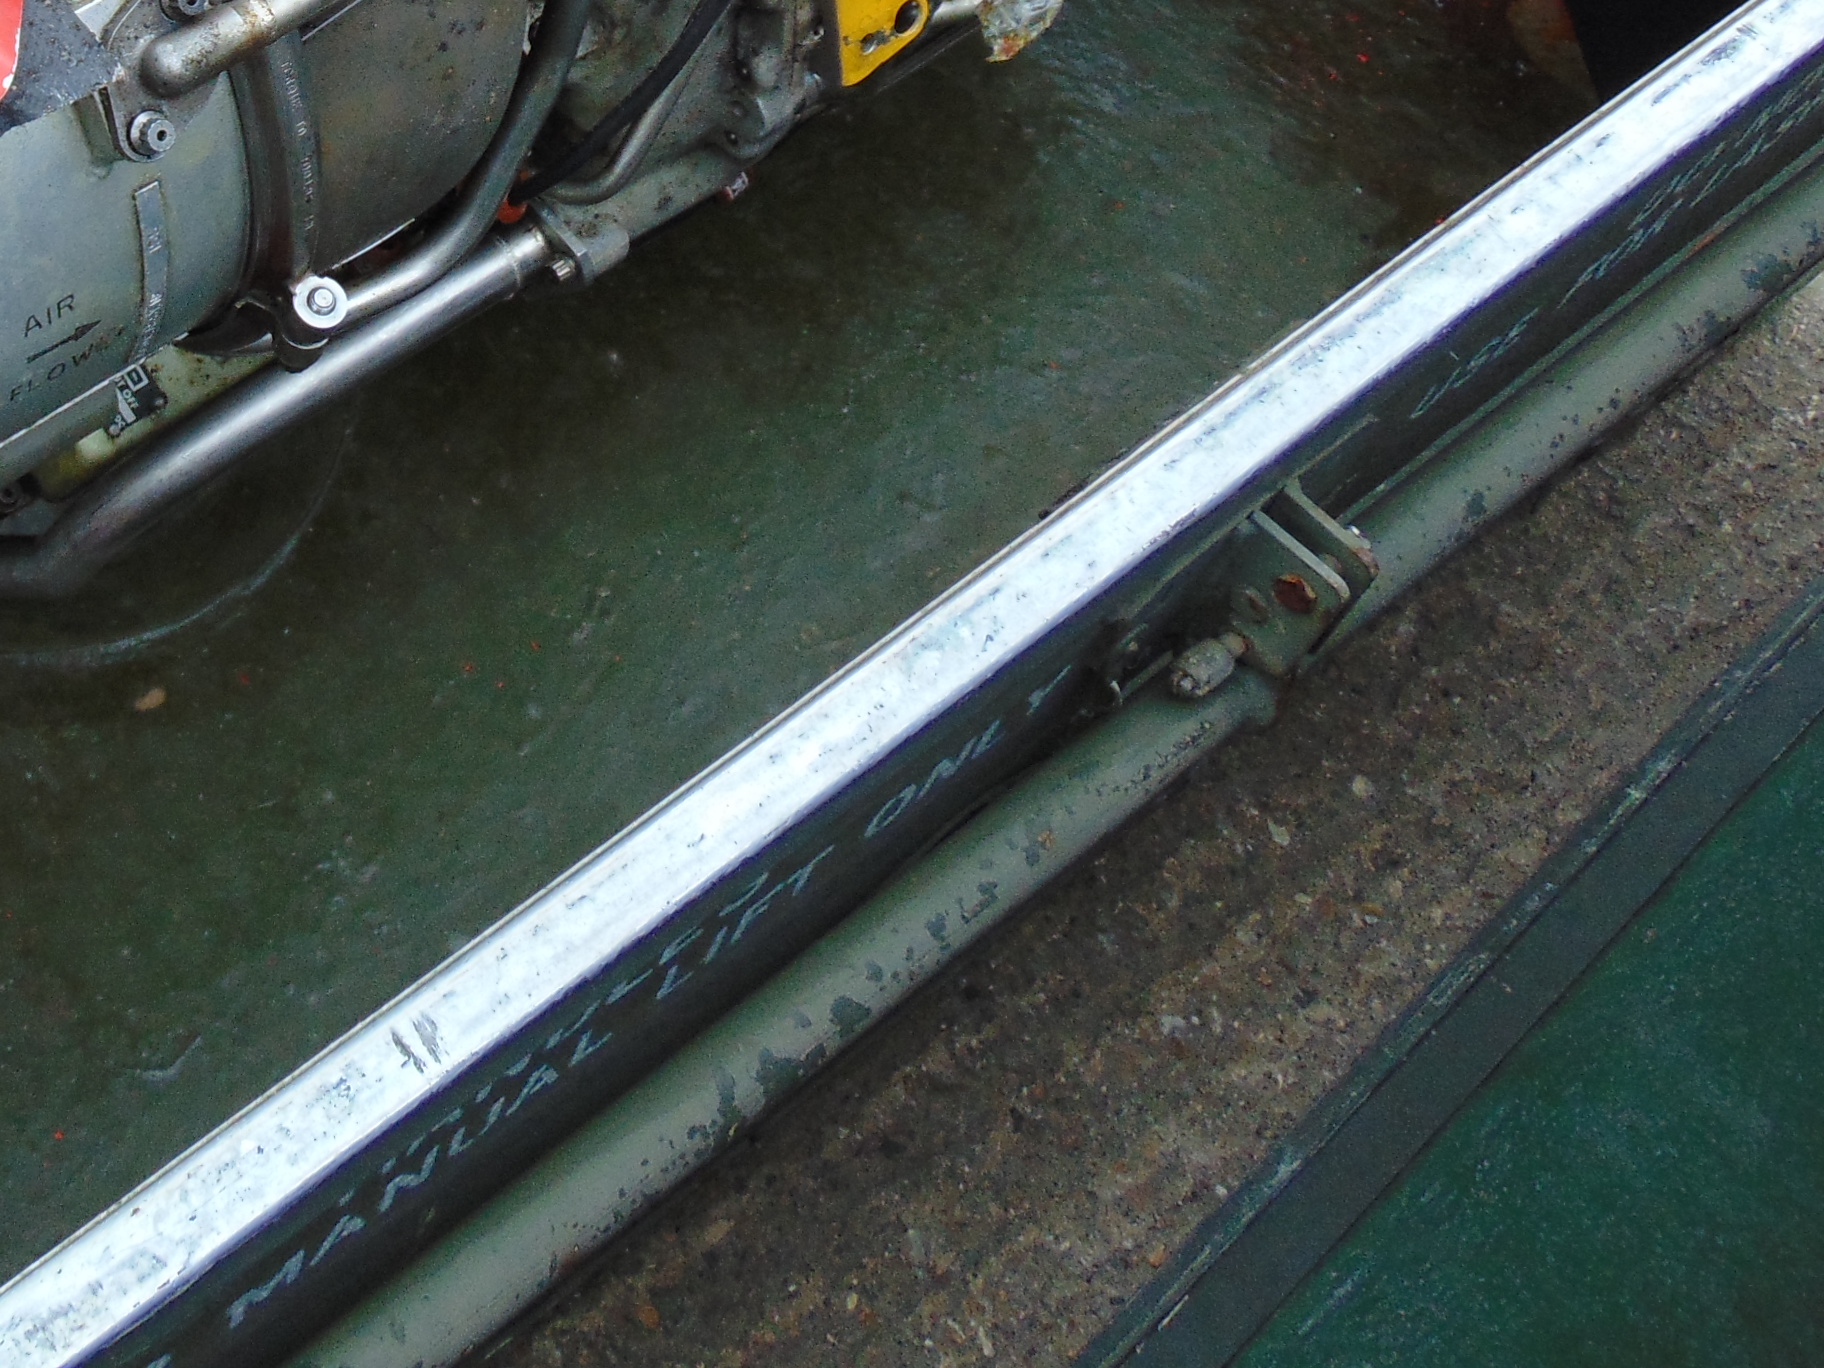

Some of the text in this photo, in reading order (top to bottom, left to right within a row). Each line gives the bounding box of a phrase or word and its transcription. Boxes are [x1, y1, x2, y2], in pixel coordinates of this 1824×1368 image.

[24, 293, 76, 338] AIR
[9, 341, 94, 402] FLOW
[226, 1029, 614, 1329] MANUAL
[656, 844, 836, 1002] LIFT
[863, 664, 1073, 838] ONLY
